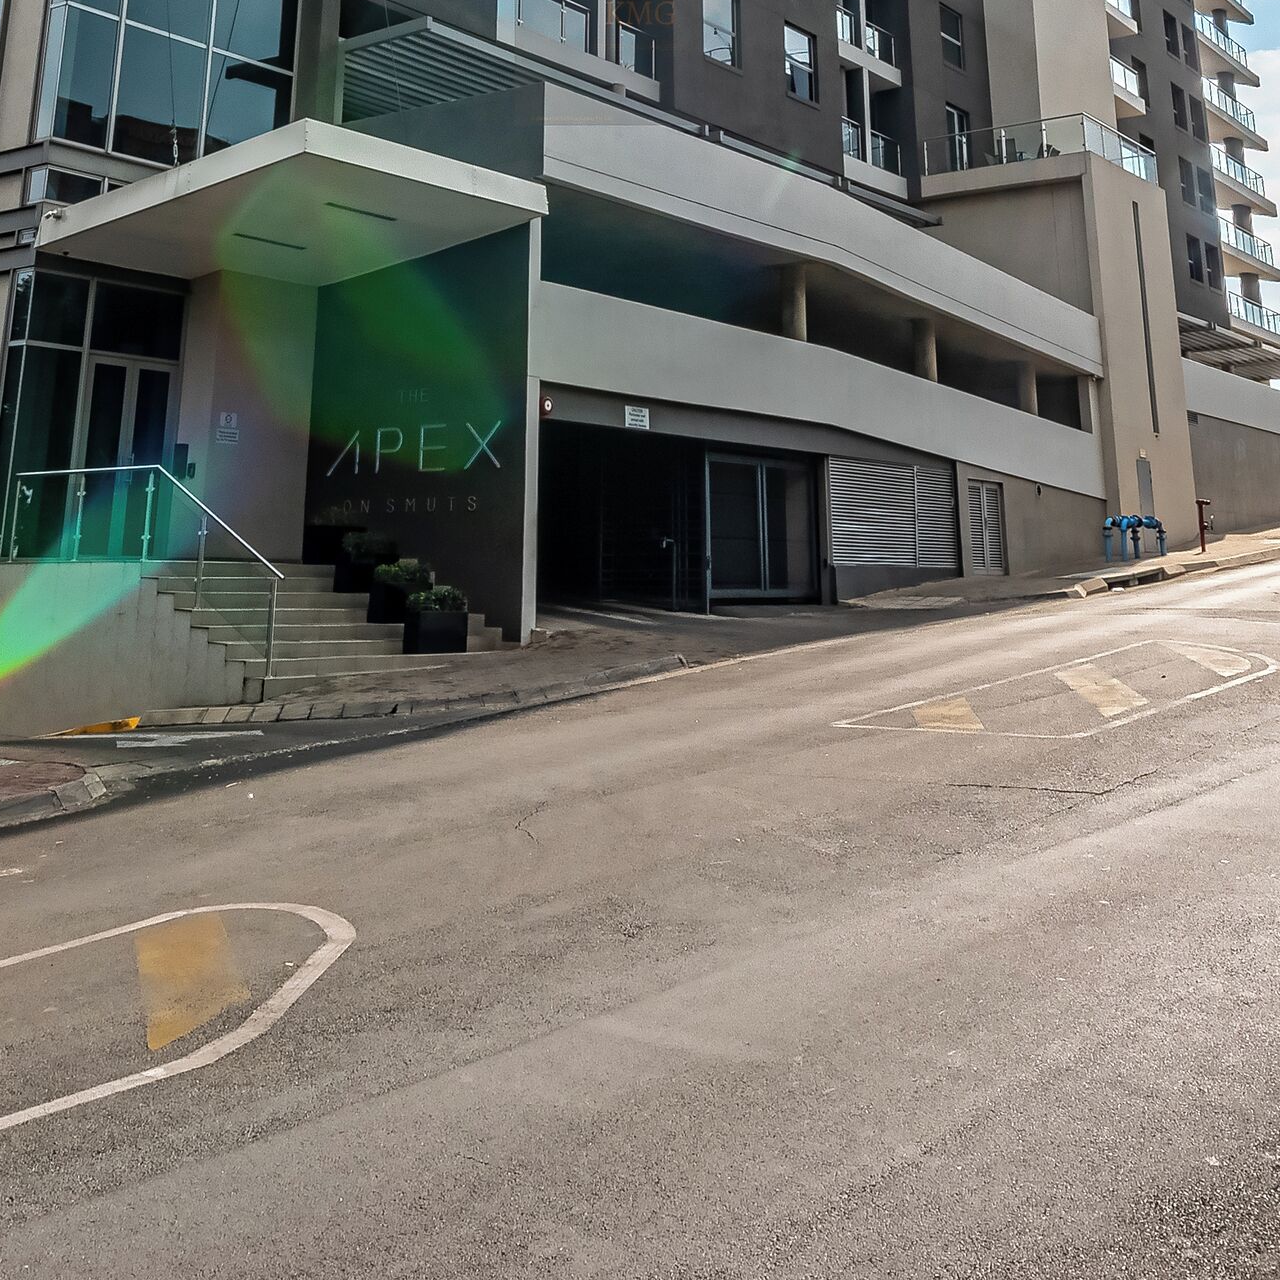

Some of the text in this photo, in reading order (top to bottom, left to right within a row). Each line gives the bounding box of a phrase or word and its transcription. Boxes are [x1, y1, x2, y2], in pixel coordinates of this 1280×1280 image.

[399, 388, 431, 404] THE
[326, 420, 502, 477] APEX
[343, 495, 480, 514] ON SMUTS
